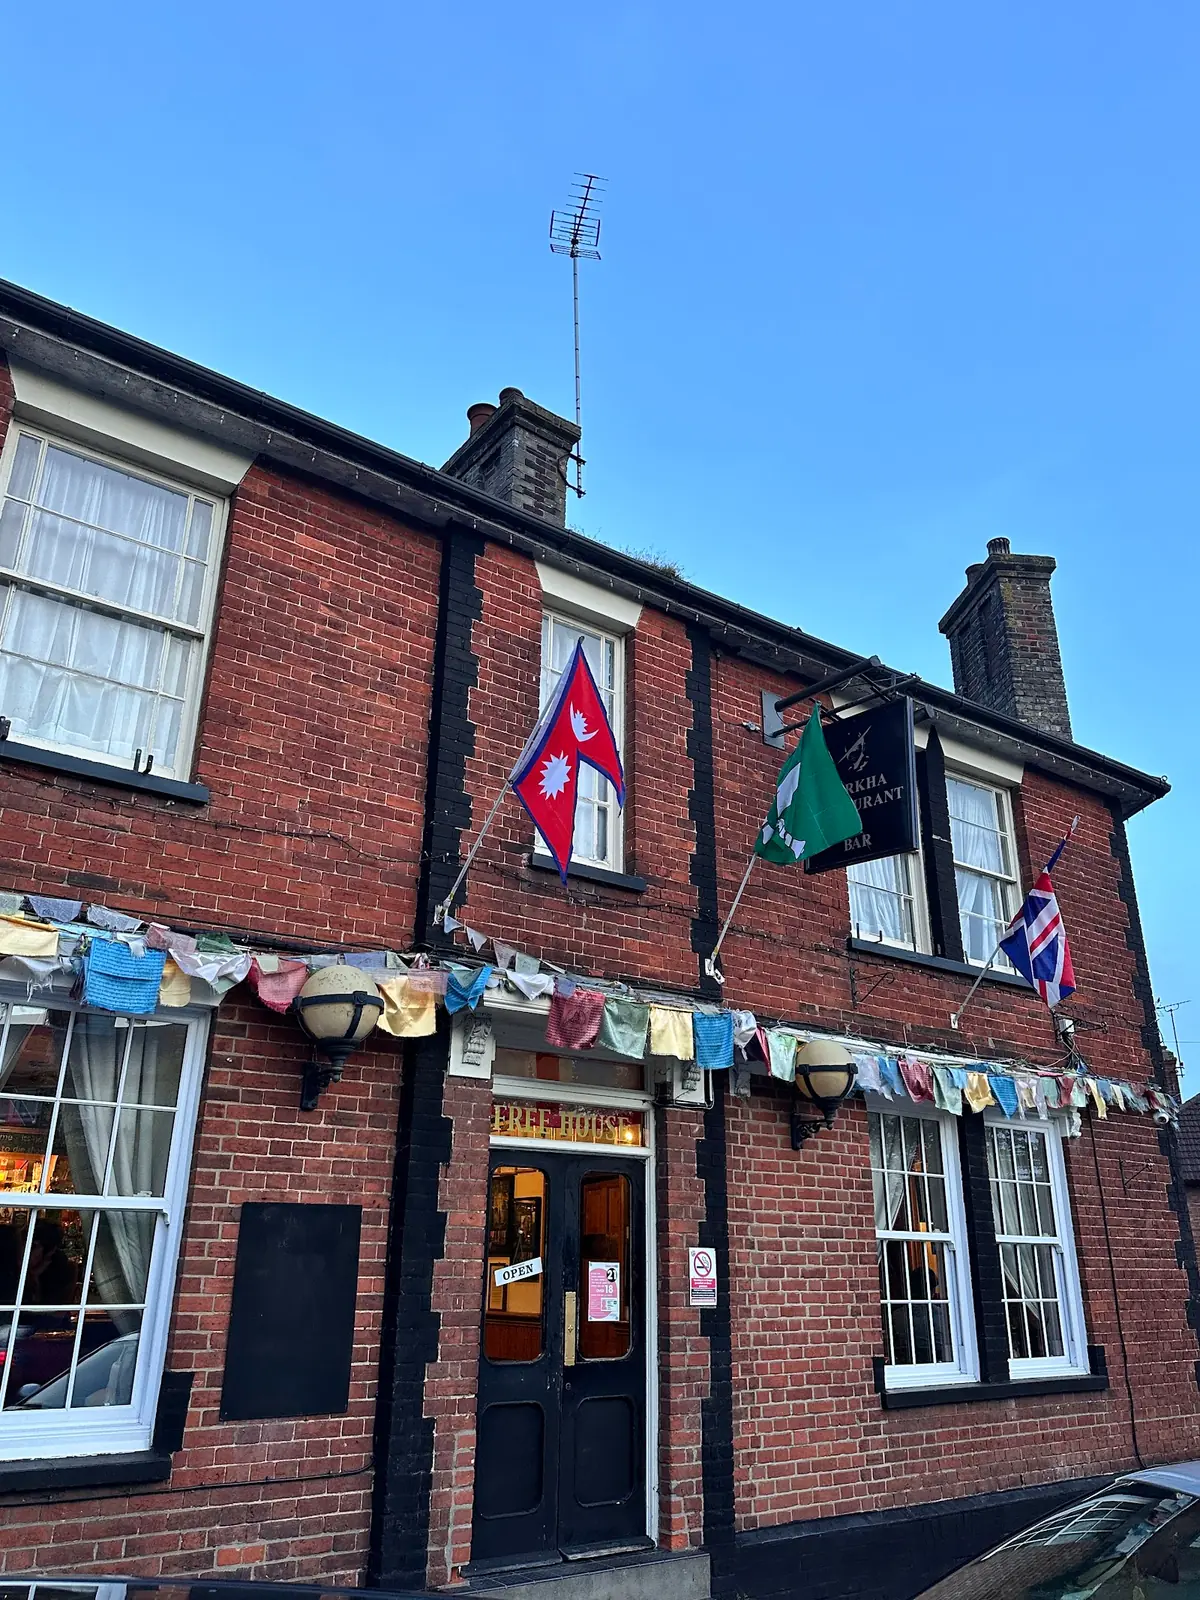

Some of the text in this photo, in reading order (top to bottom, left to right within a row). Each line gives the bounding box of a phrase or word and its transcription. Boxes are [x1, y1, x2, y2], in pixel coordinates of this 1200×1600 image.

[845, 773, 887, 794] RKHA
[854, 785, 904, 811] URANT
[844, 834, 872, 852] BAR
[493, 1104, 633, 1142] FREE HOUSE
[502, 1263, 534, 1281] OPEN
[607, 1269, 617, 1280] 21
[605, 1284, 614, 1293] 18
